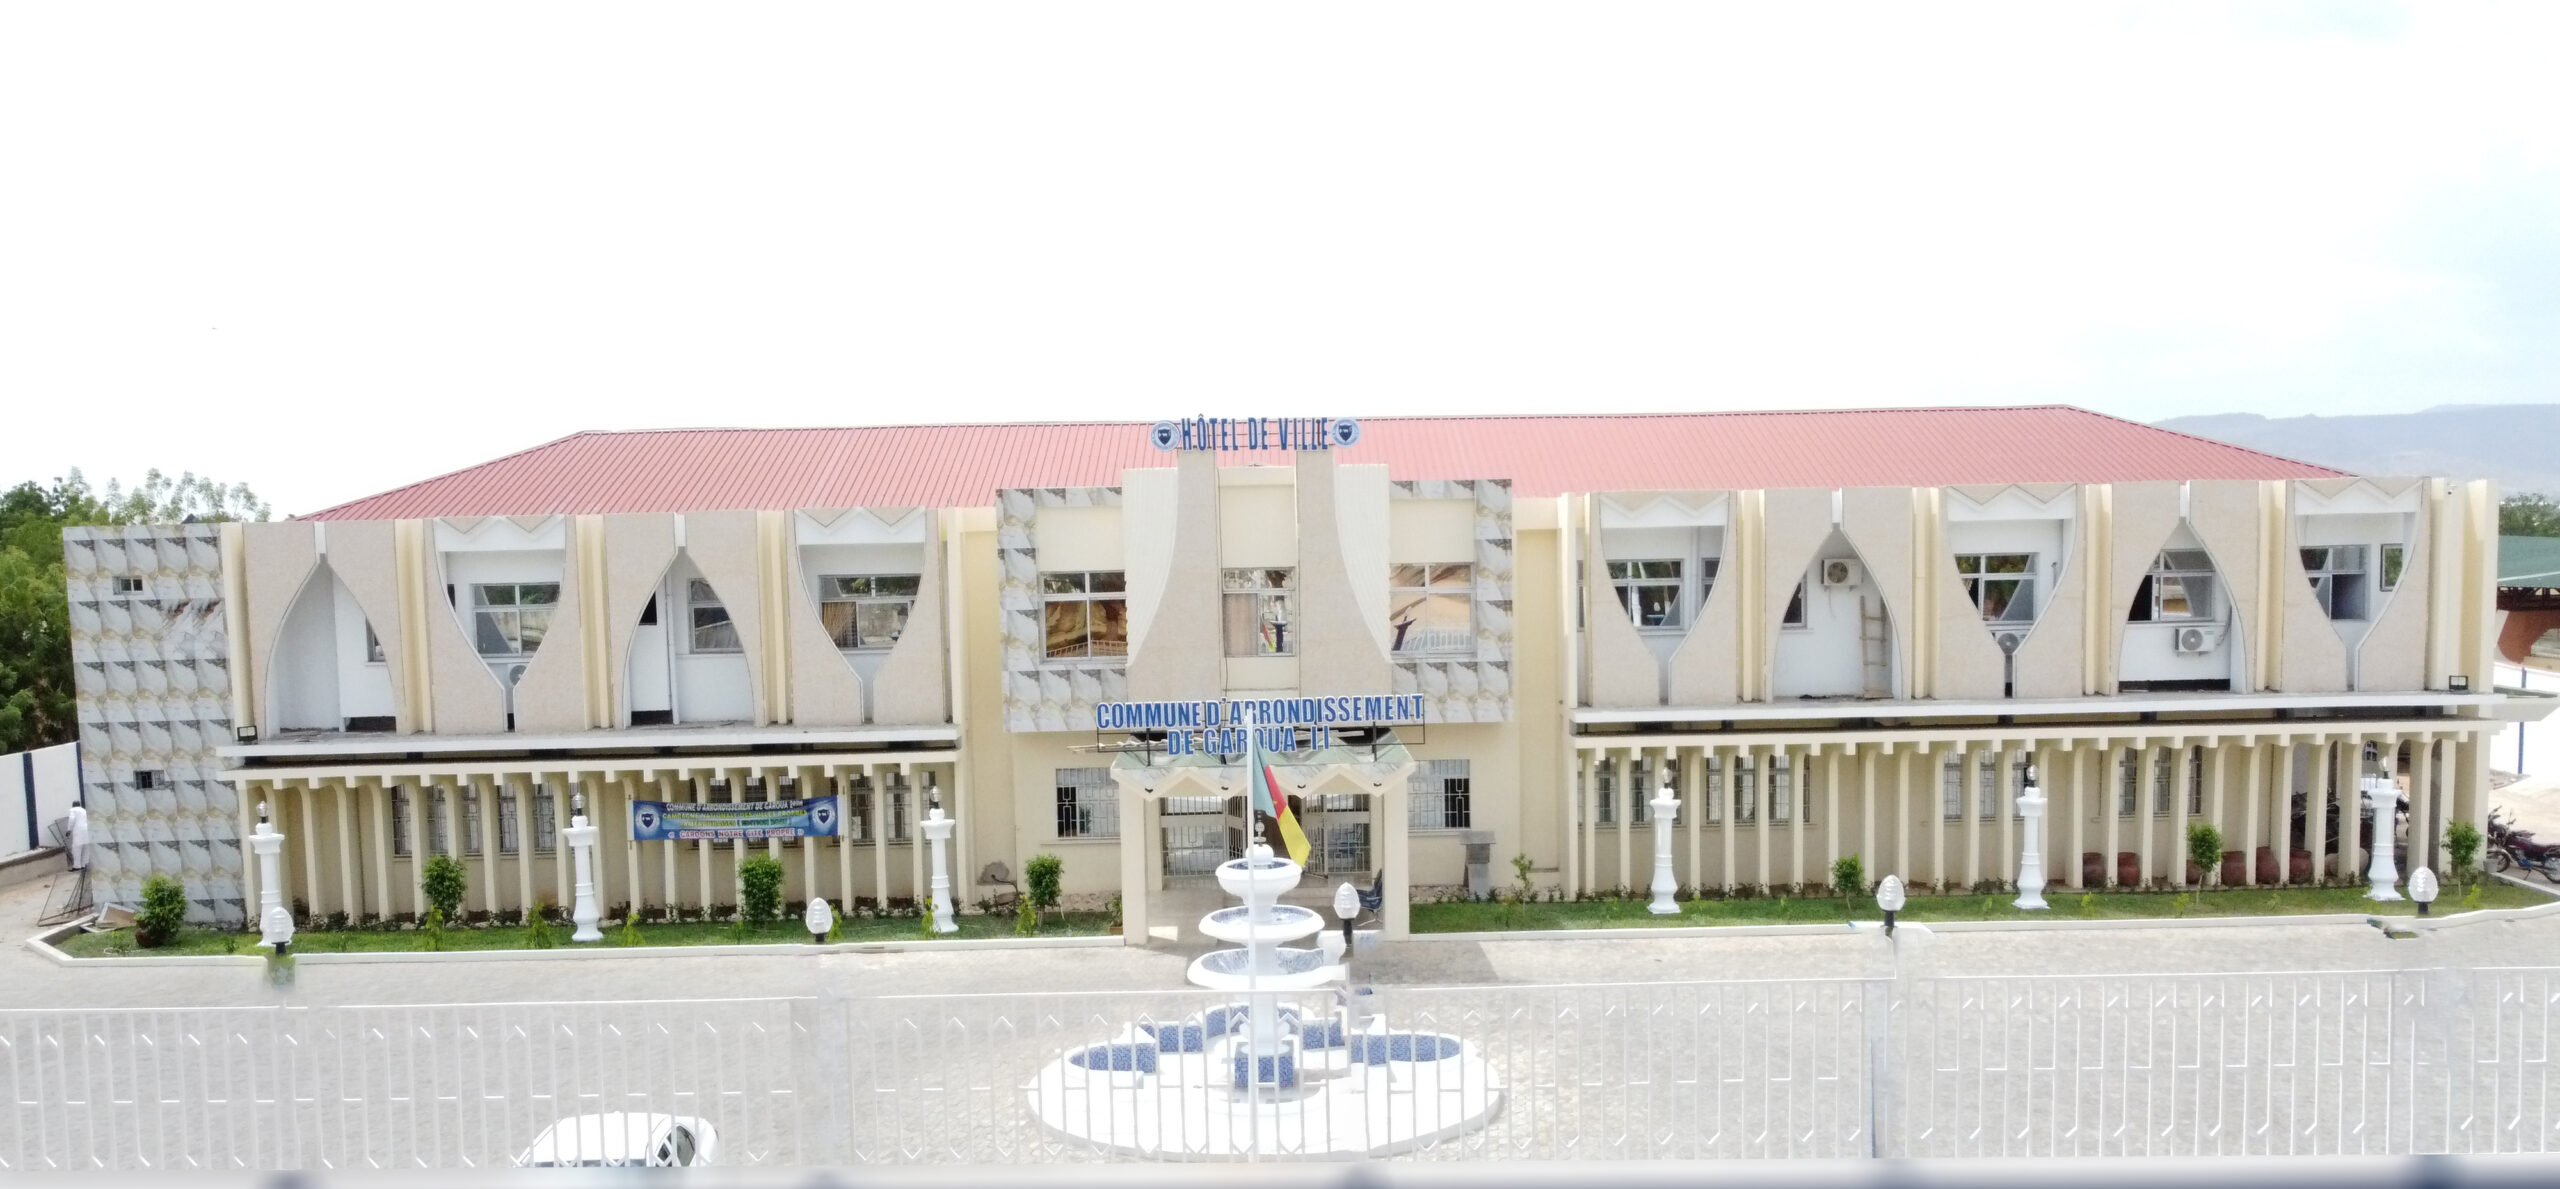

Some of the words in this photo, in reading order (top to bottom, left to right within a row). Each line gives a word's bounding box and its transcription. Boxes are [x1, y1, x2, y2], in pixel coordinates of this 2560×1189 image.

[1181, 413, 1239, 450] HÔTEL
[1248, 417, 1269, 450] DE
[1278, 416, 1328, 450] VILLE
[1097, 701, 1202, 729] COMMUNE
[1167, 729, 1195, 756] DE
[1310, 724, 1331, 751] II
[666, 802, 696, 811] COMMUNE
[756, 801, 765, 810] DE
[765, 800, 788, 810] GAROUA
[680, 830, 715, 839] GARDONS
[718, 829, 743, 838] NOTRE
[766, 828, 795, 837] PROPRE
